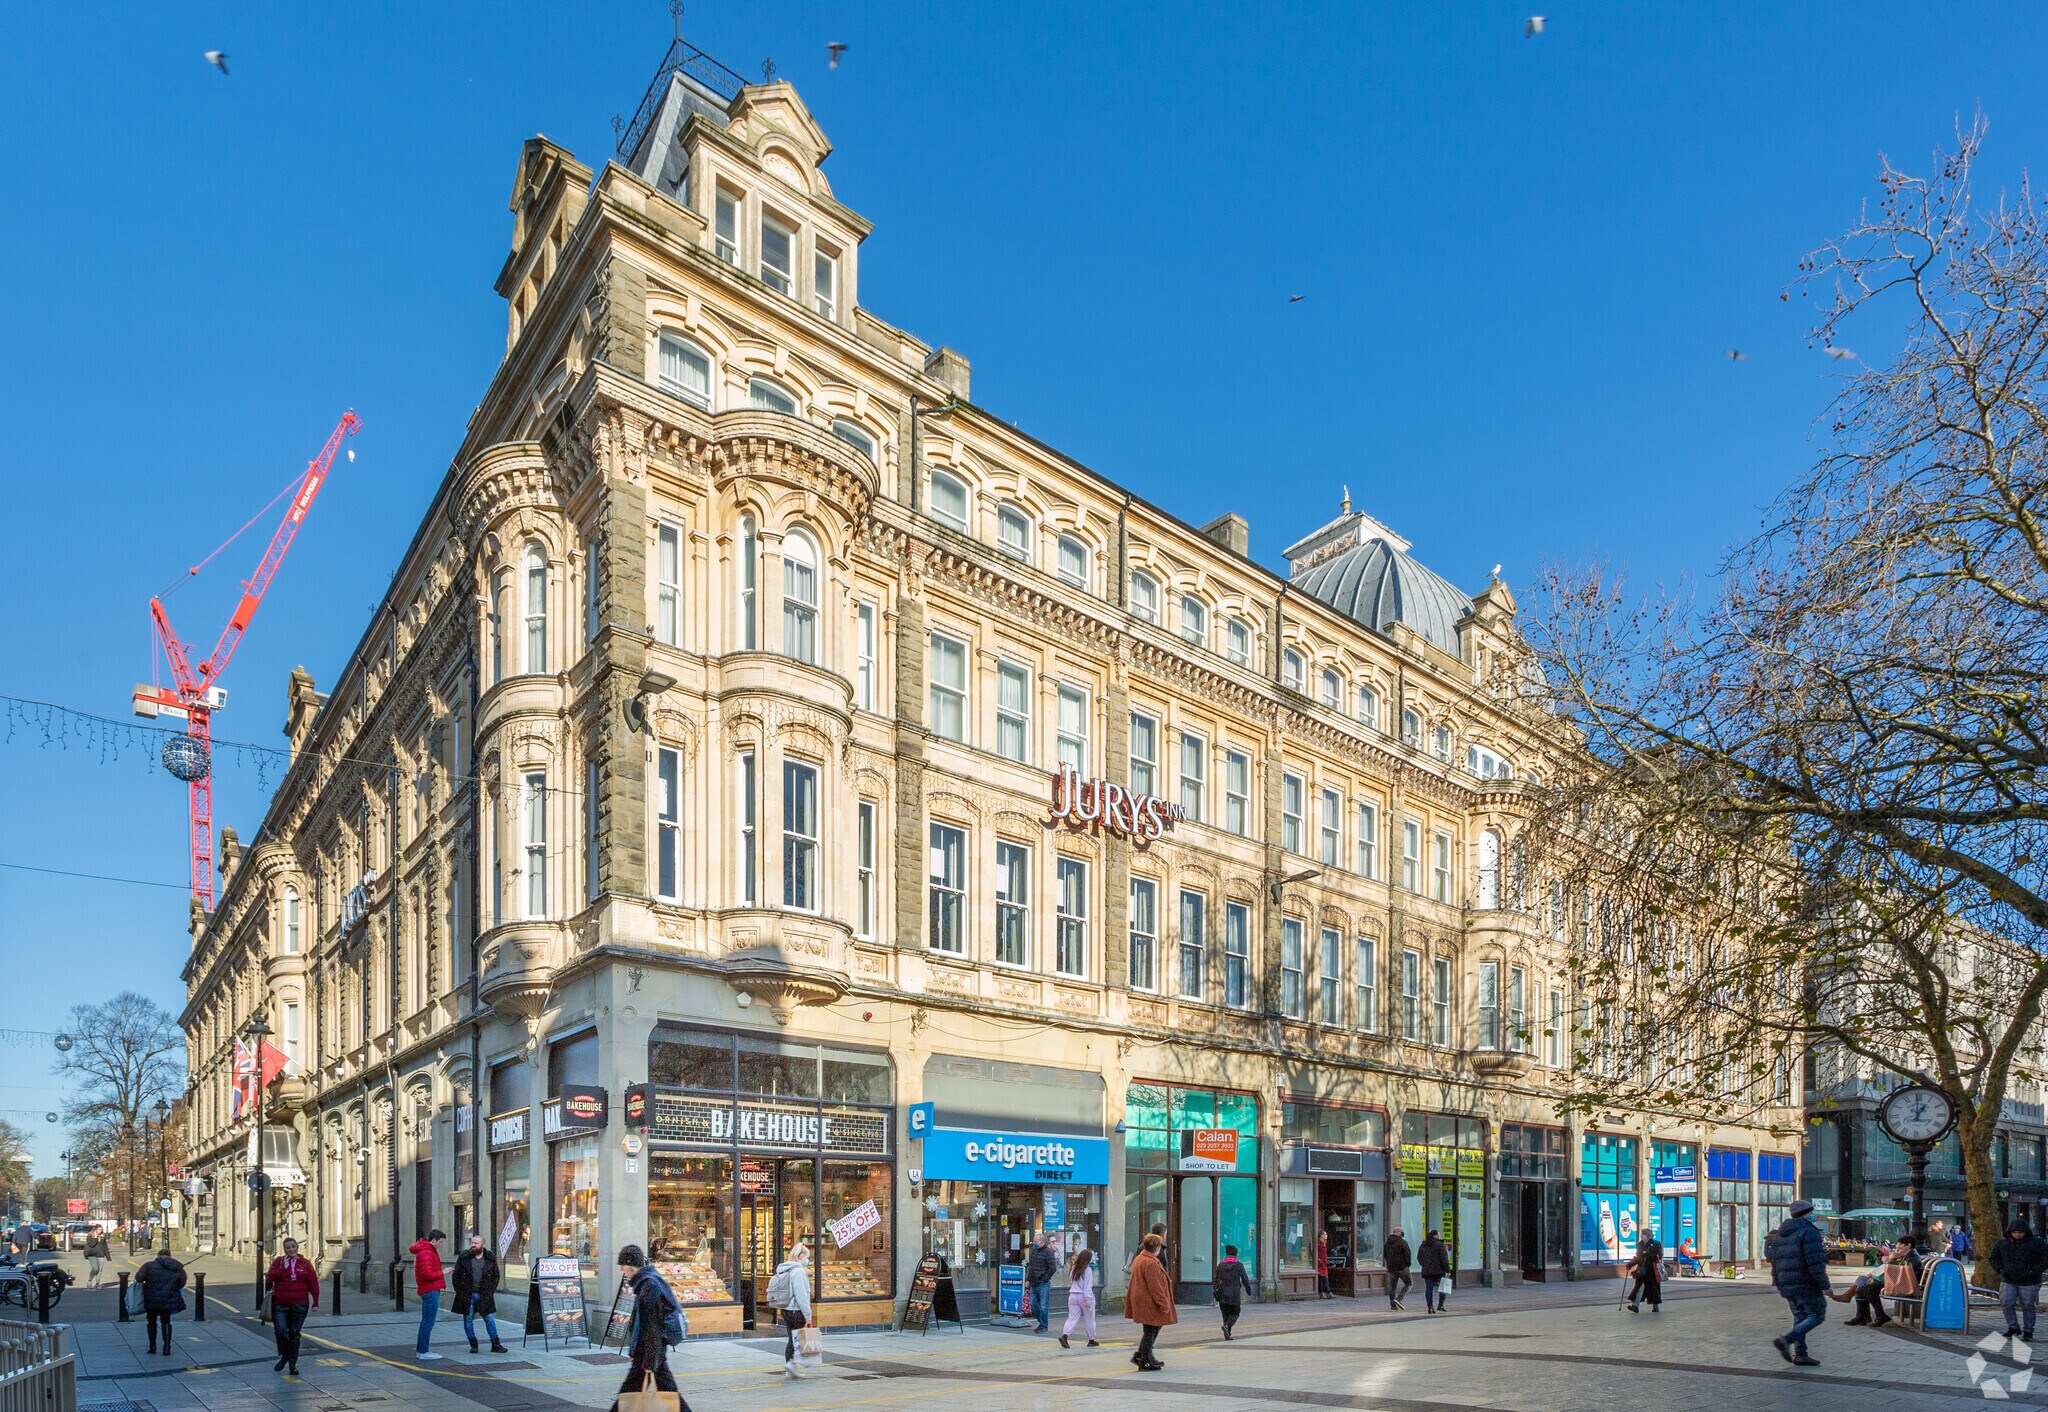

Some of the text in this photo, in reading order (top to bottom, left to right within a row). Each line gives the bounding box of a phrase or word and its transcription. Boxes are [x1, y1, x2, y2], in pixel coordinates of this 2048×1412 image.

[299, 475, 319, 507] WOLFFKRAN
[1049, 761, 1187, 841] JURYS INN
[566, 1101, 602, 1112] BAKEHOUSE
[912, 1109, 925, 1130] e
[656, 1115, 698, 1126] ORNISH
[711, 1109, 832, 1144] BAKEHOUSE
[1197, 1131, 1234, 1142] Calan.
[965, 1137, 1074, 1168] e-cigarette
[1034, 1169, 1073, 1181] DIRECT
[832, 1201, 873, 1231] OPENING OFFER
[835, 1207, 877, 1242] 25% OFF
[540, 1264, 556, 1272] 25%
